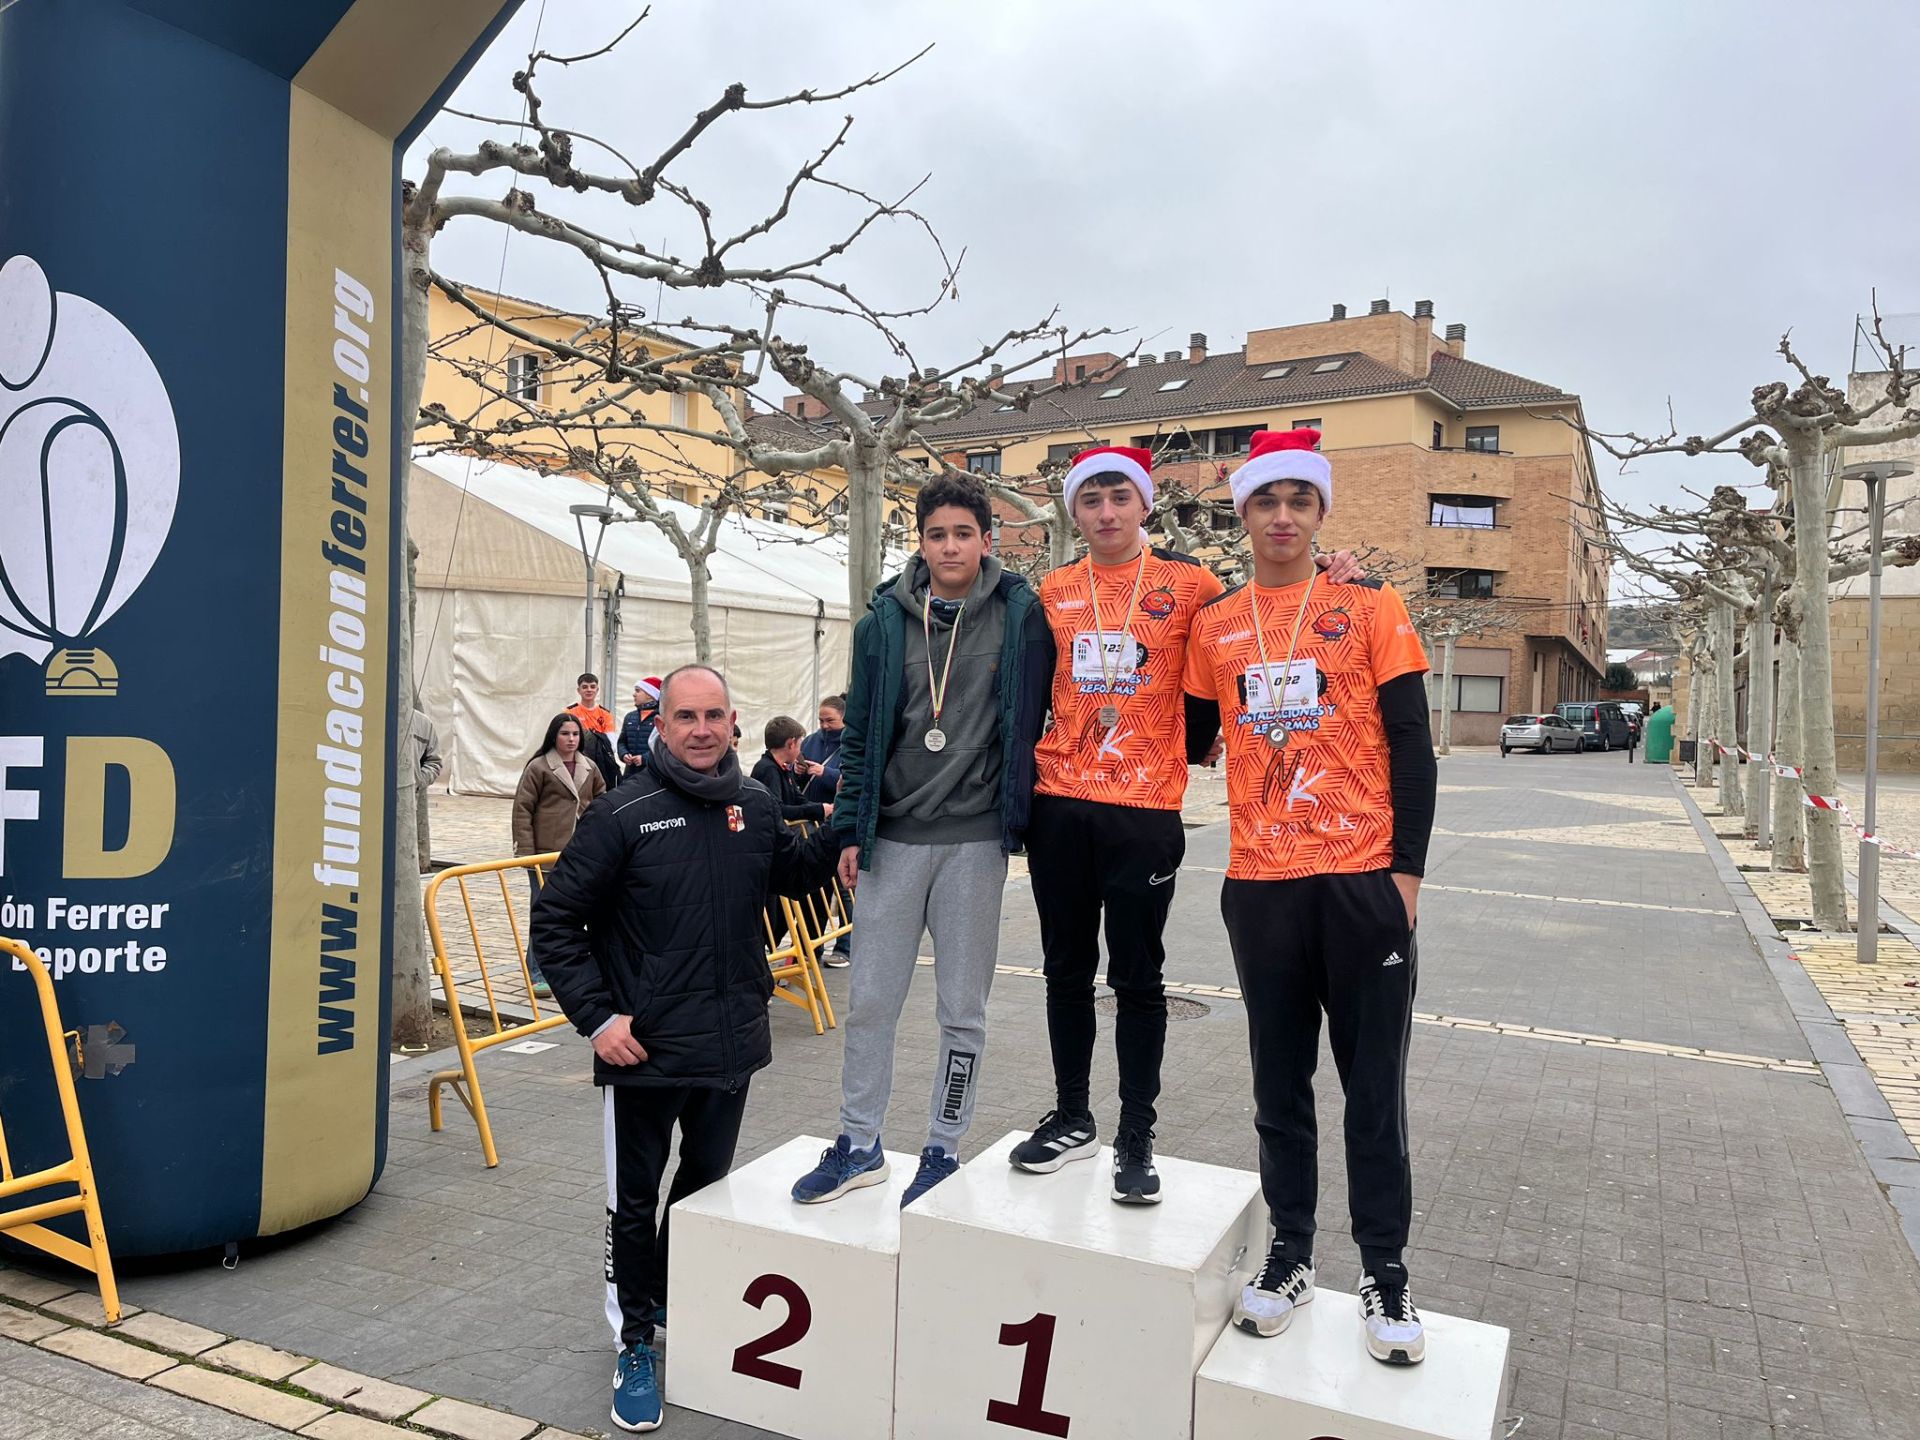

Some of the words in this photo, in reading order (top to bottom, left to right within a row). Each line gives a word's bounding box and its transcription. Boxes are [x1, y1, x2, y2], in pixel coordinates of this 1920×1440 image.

[313, 268, 374, 1056] www.fundacionferrer.org
[1079, 684, 1136, 696] REFOMAS
[1144, 674, 1152, 686] Y
[1327, 704, 1337, 717] Y
[1252, 719, 1319, 736] RERMAS
[640, 816, 686, 833] macron
[47, 897, 170, 931] Ferrer
[943, 1071, 967, 1121] PUMA
[732, 1273, 812, 1390] 2
[987, 1312, 1071, 1439] 1
